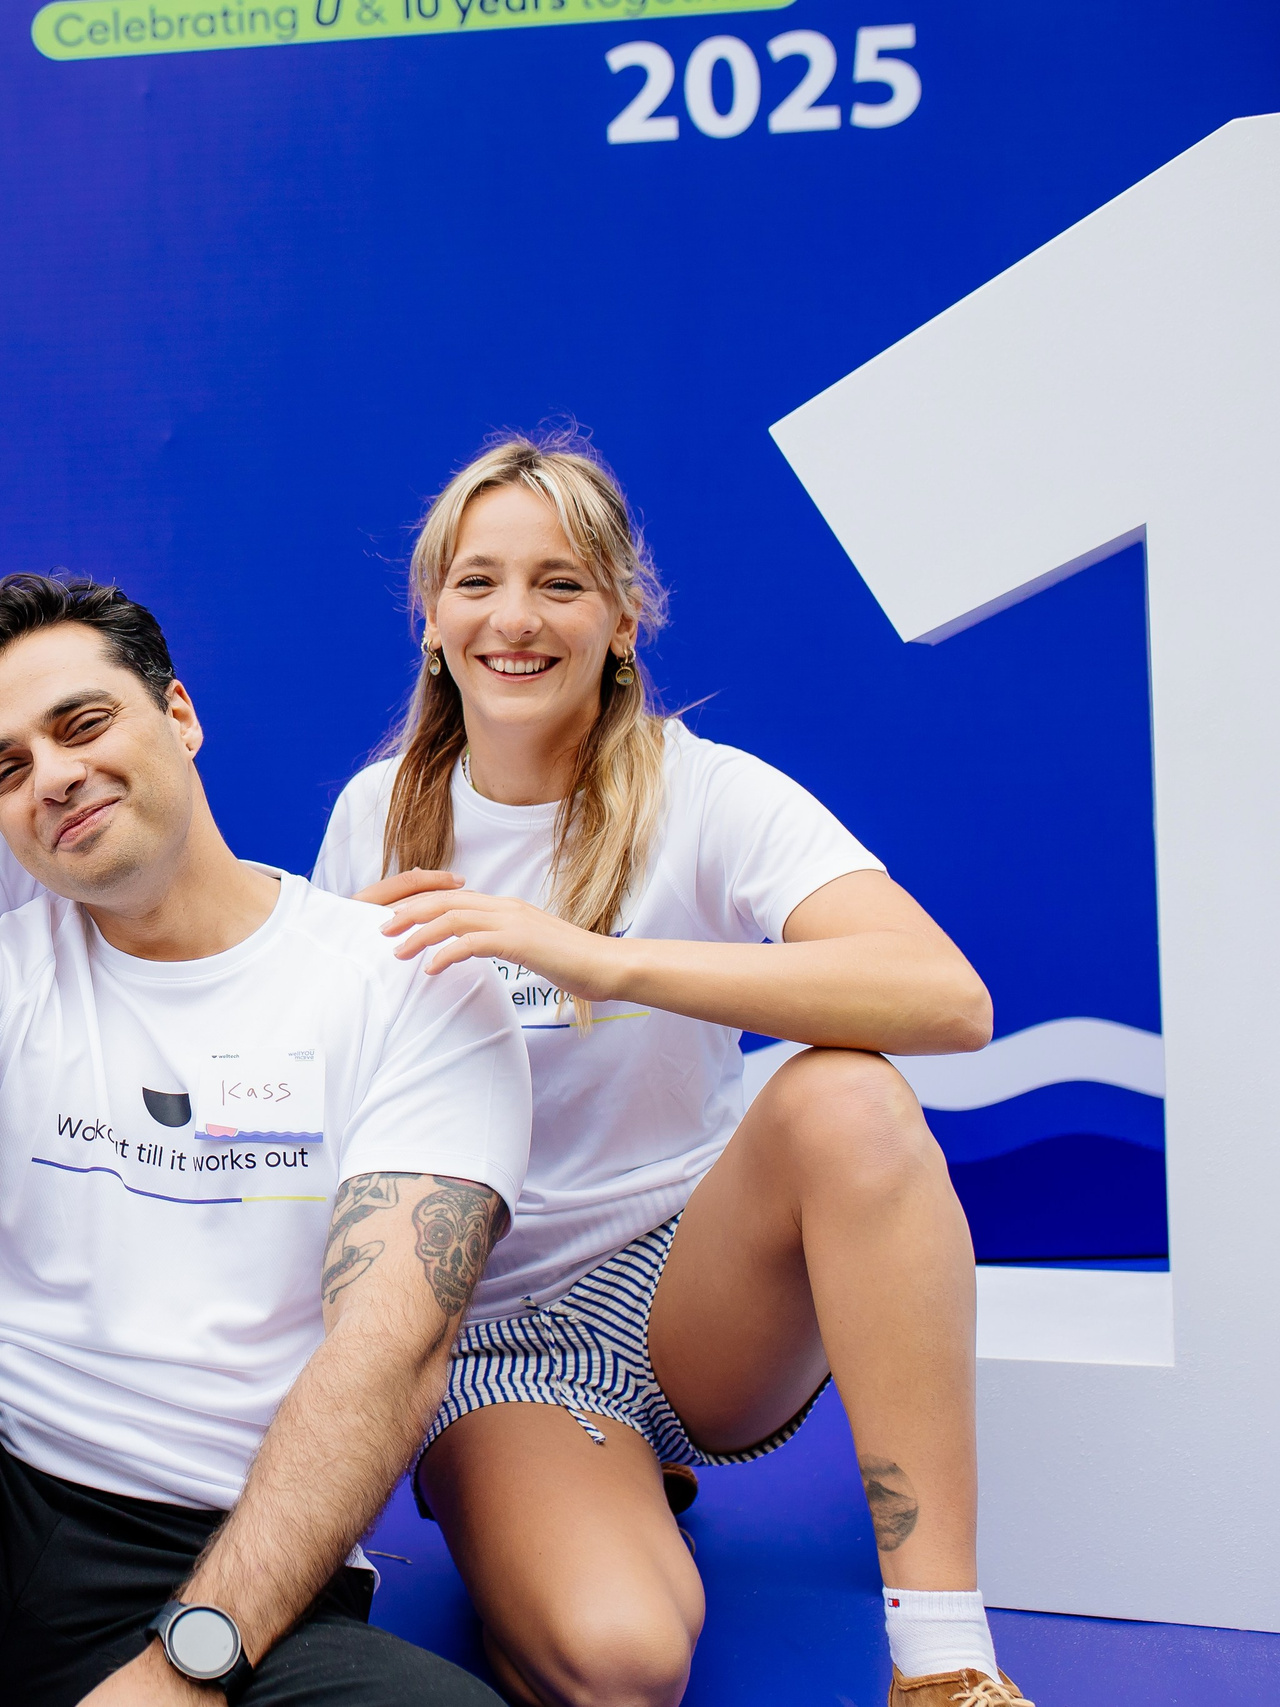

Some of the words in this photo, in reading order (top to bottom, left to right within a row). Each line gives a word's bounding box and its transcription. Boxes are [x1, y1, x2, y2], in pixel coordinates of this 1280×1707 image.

[54, 1, 298, 47] Celebrating
[356, 0, 387, 25] &
[605, 24, 923, 145] 2025
[222, 1080, 291, 1107] Kass
[137, 1143, 163, 1167] till
[170, 1150, 187, 1171] it
[193, 1149, 257, 1172] works
[265, 1147, 309, 1168] out
